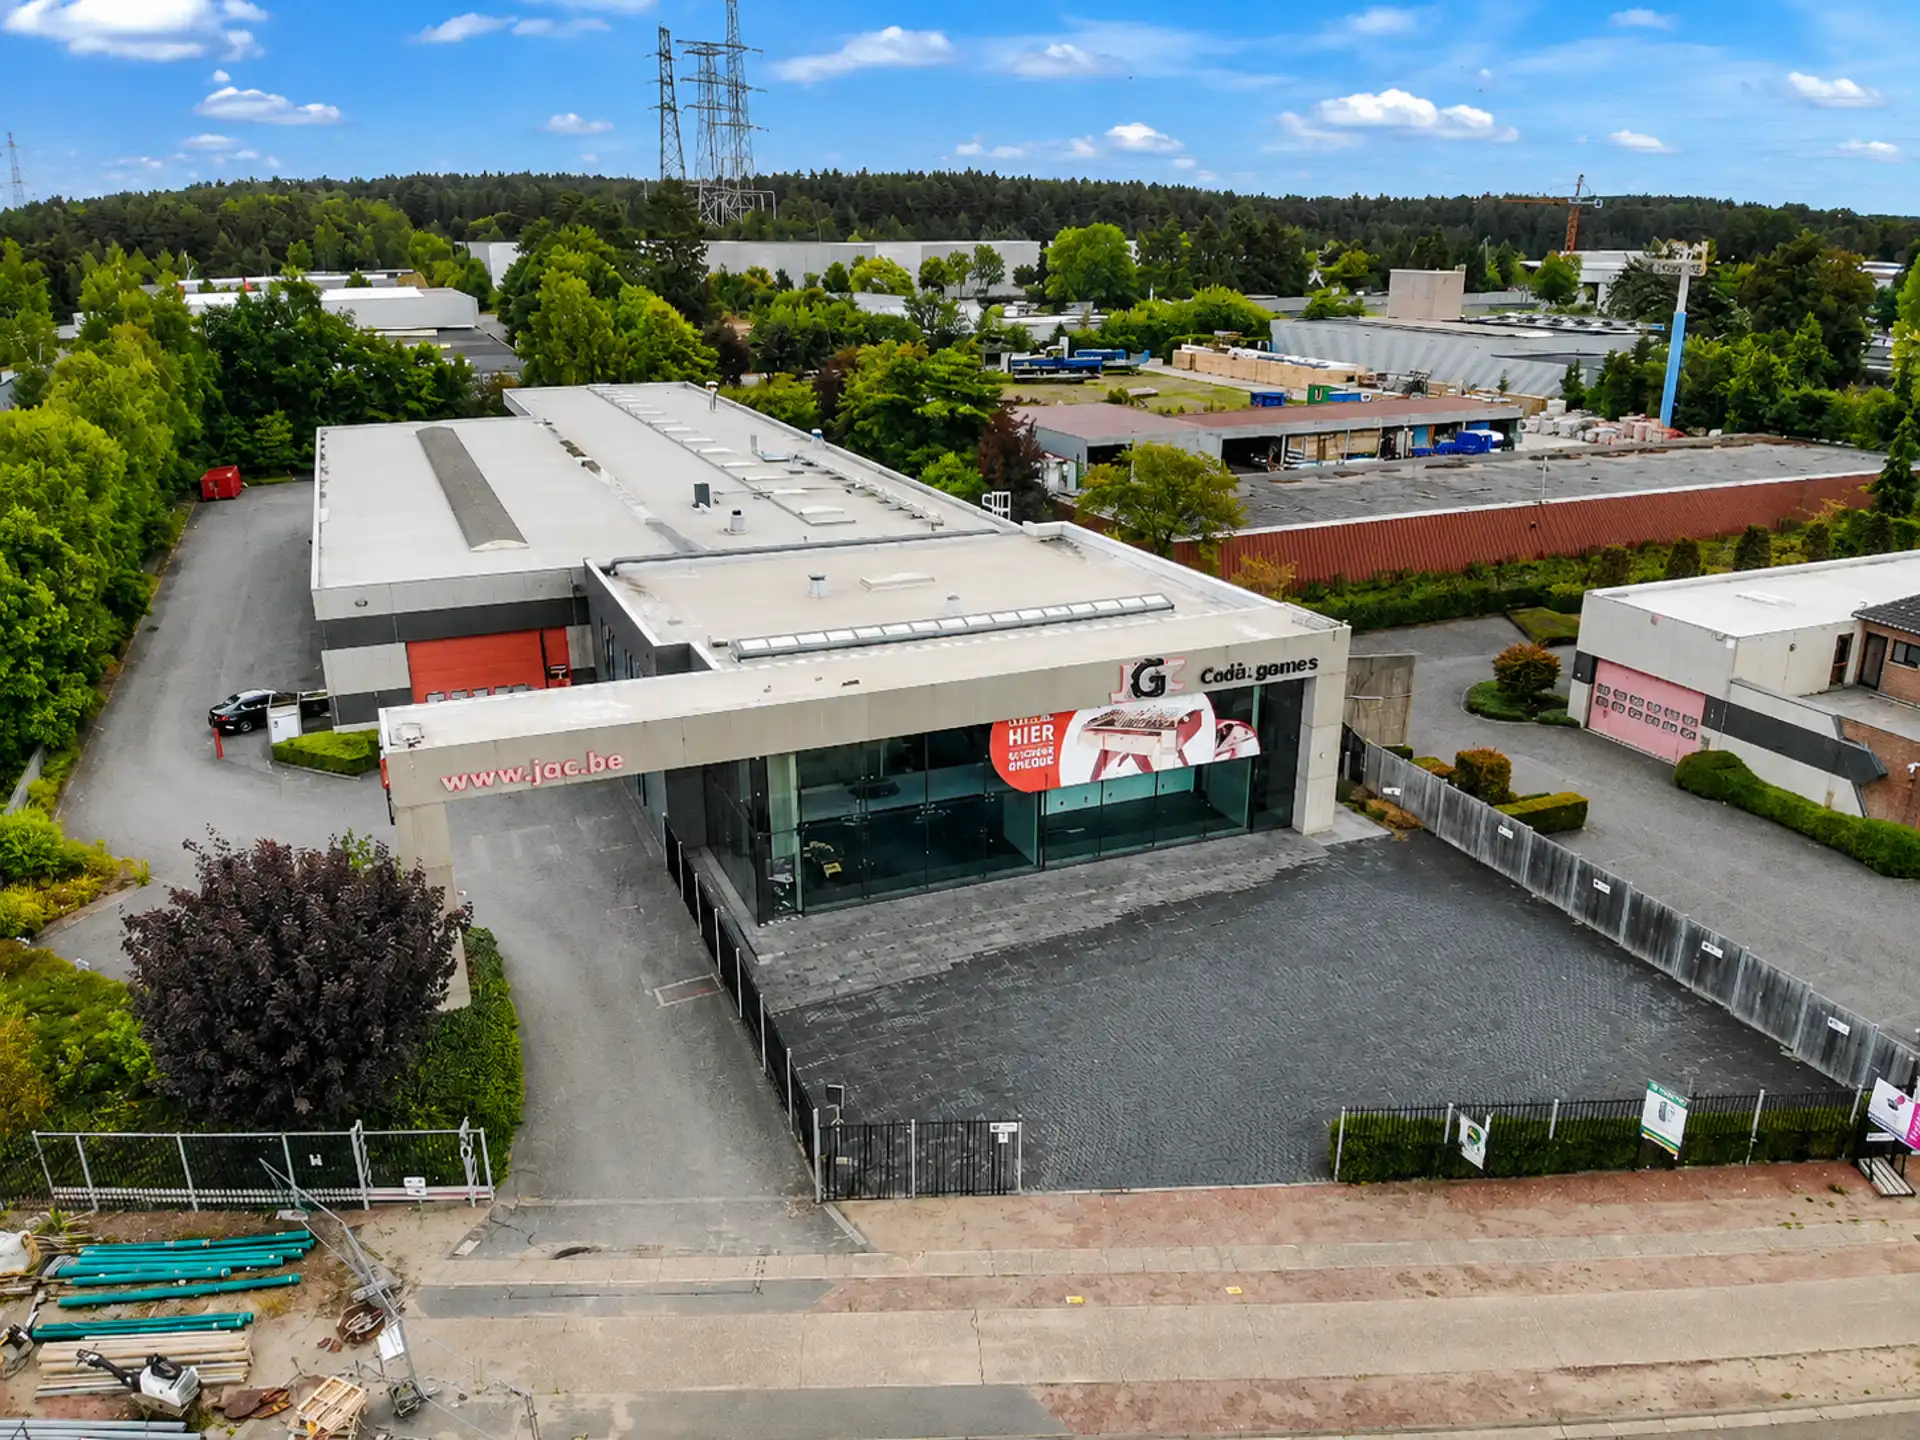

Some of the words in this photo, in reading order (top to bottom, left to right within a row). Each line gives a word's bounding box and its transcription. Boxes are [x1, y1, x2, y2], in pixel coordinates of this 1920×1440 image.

[1255, 657, 1318, 681] games
[1008, 724, 1054, 746] HIER
[440, 751, 624, 792] www.jac.be
